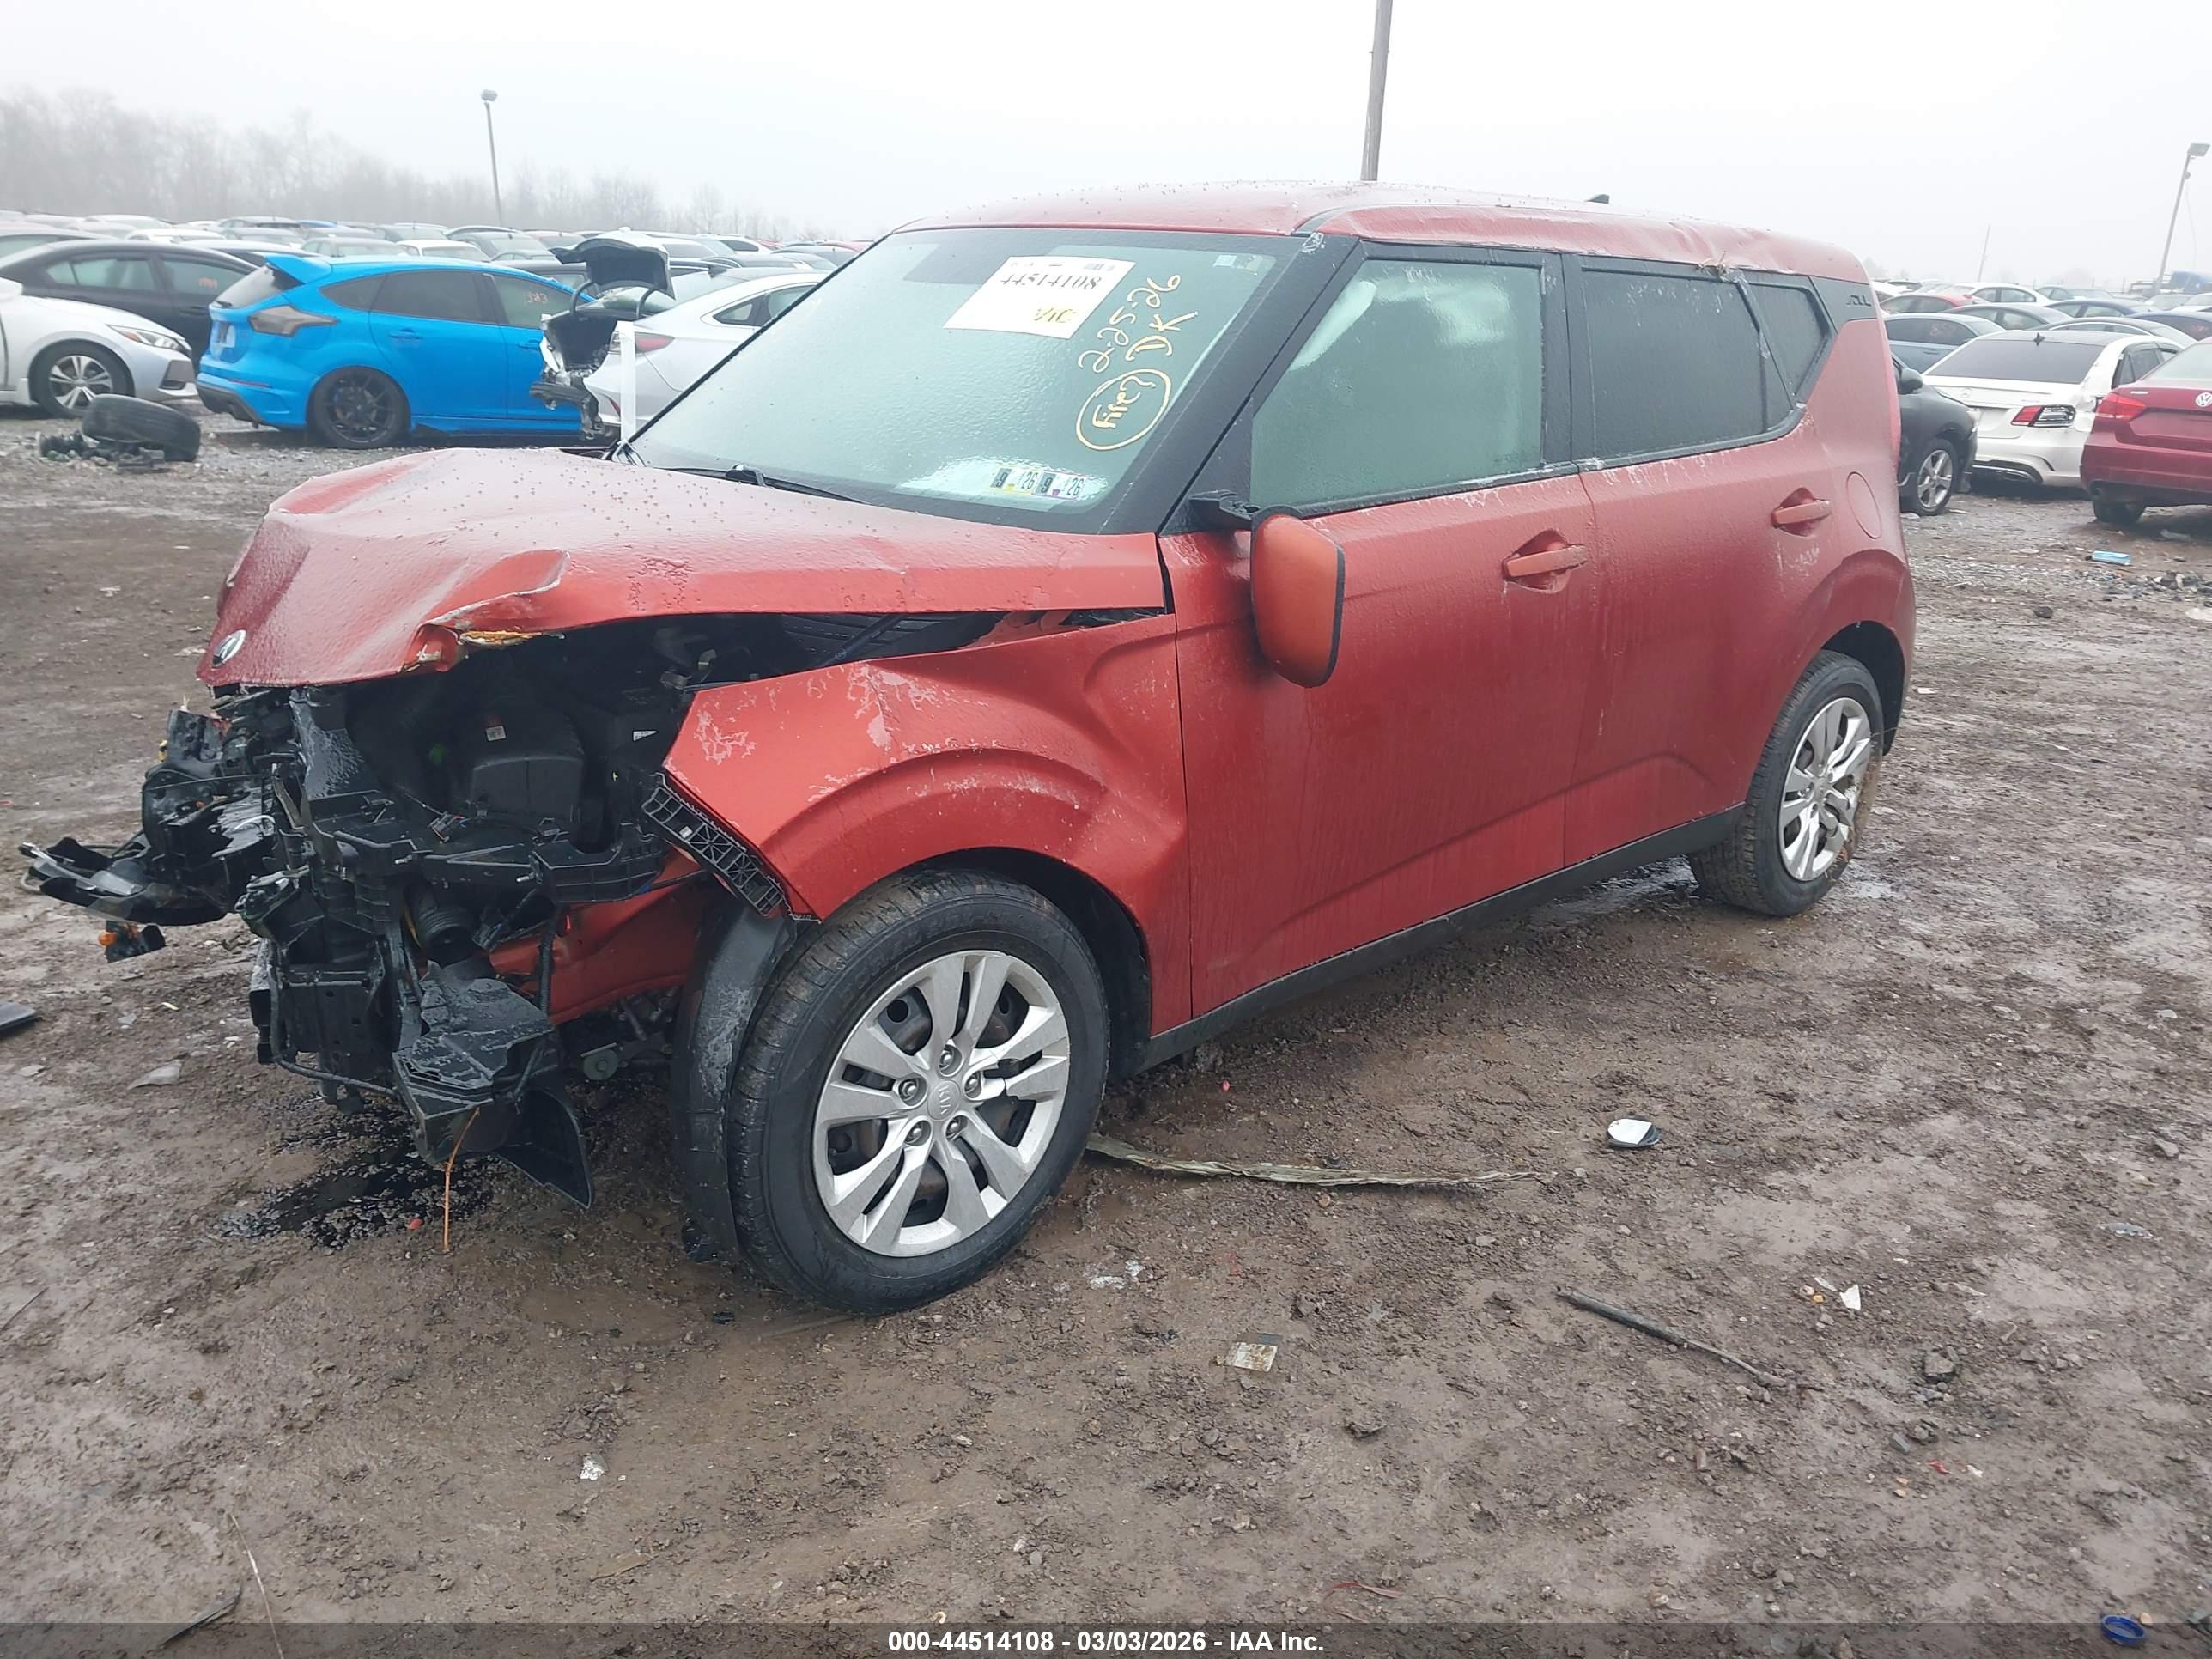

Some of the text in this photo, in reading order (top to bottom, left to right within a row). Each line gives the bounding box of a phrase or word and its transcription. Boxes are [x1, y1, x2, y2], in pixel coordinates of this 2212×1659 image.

[1000, 274, 1103, 290] 44514108
[996, 471, 1038, 489] 9 26
[1041, 477, 1085, 496] 9 26
